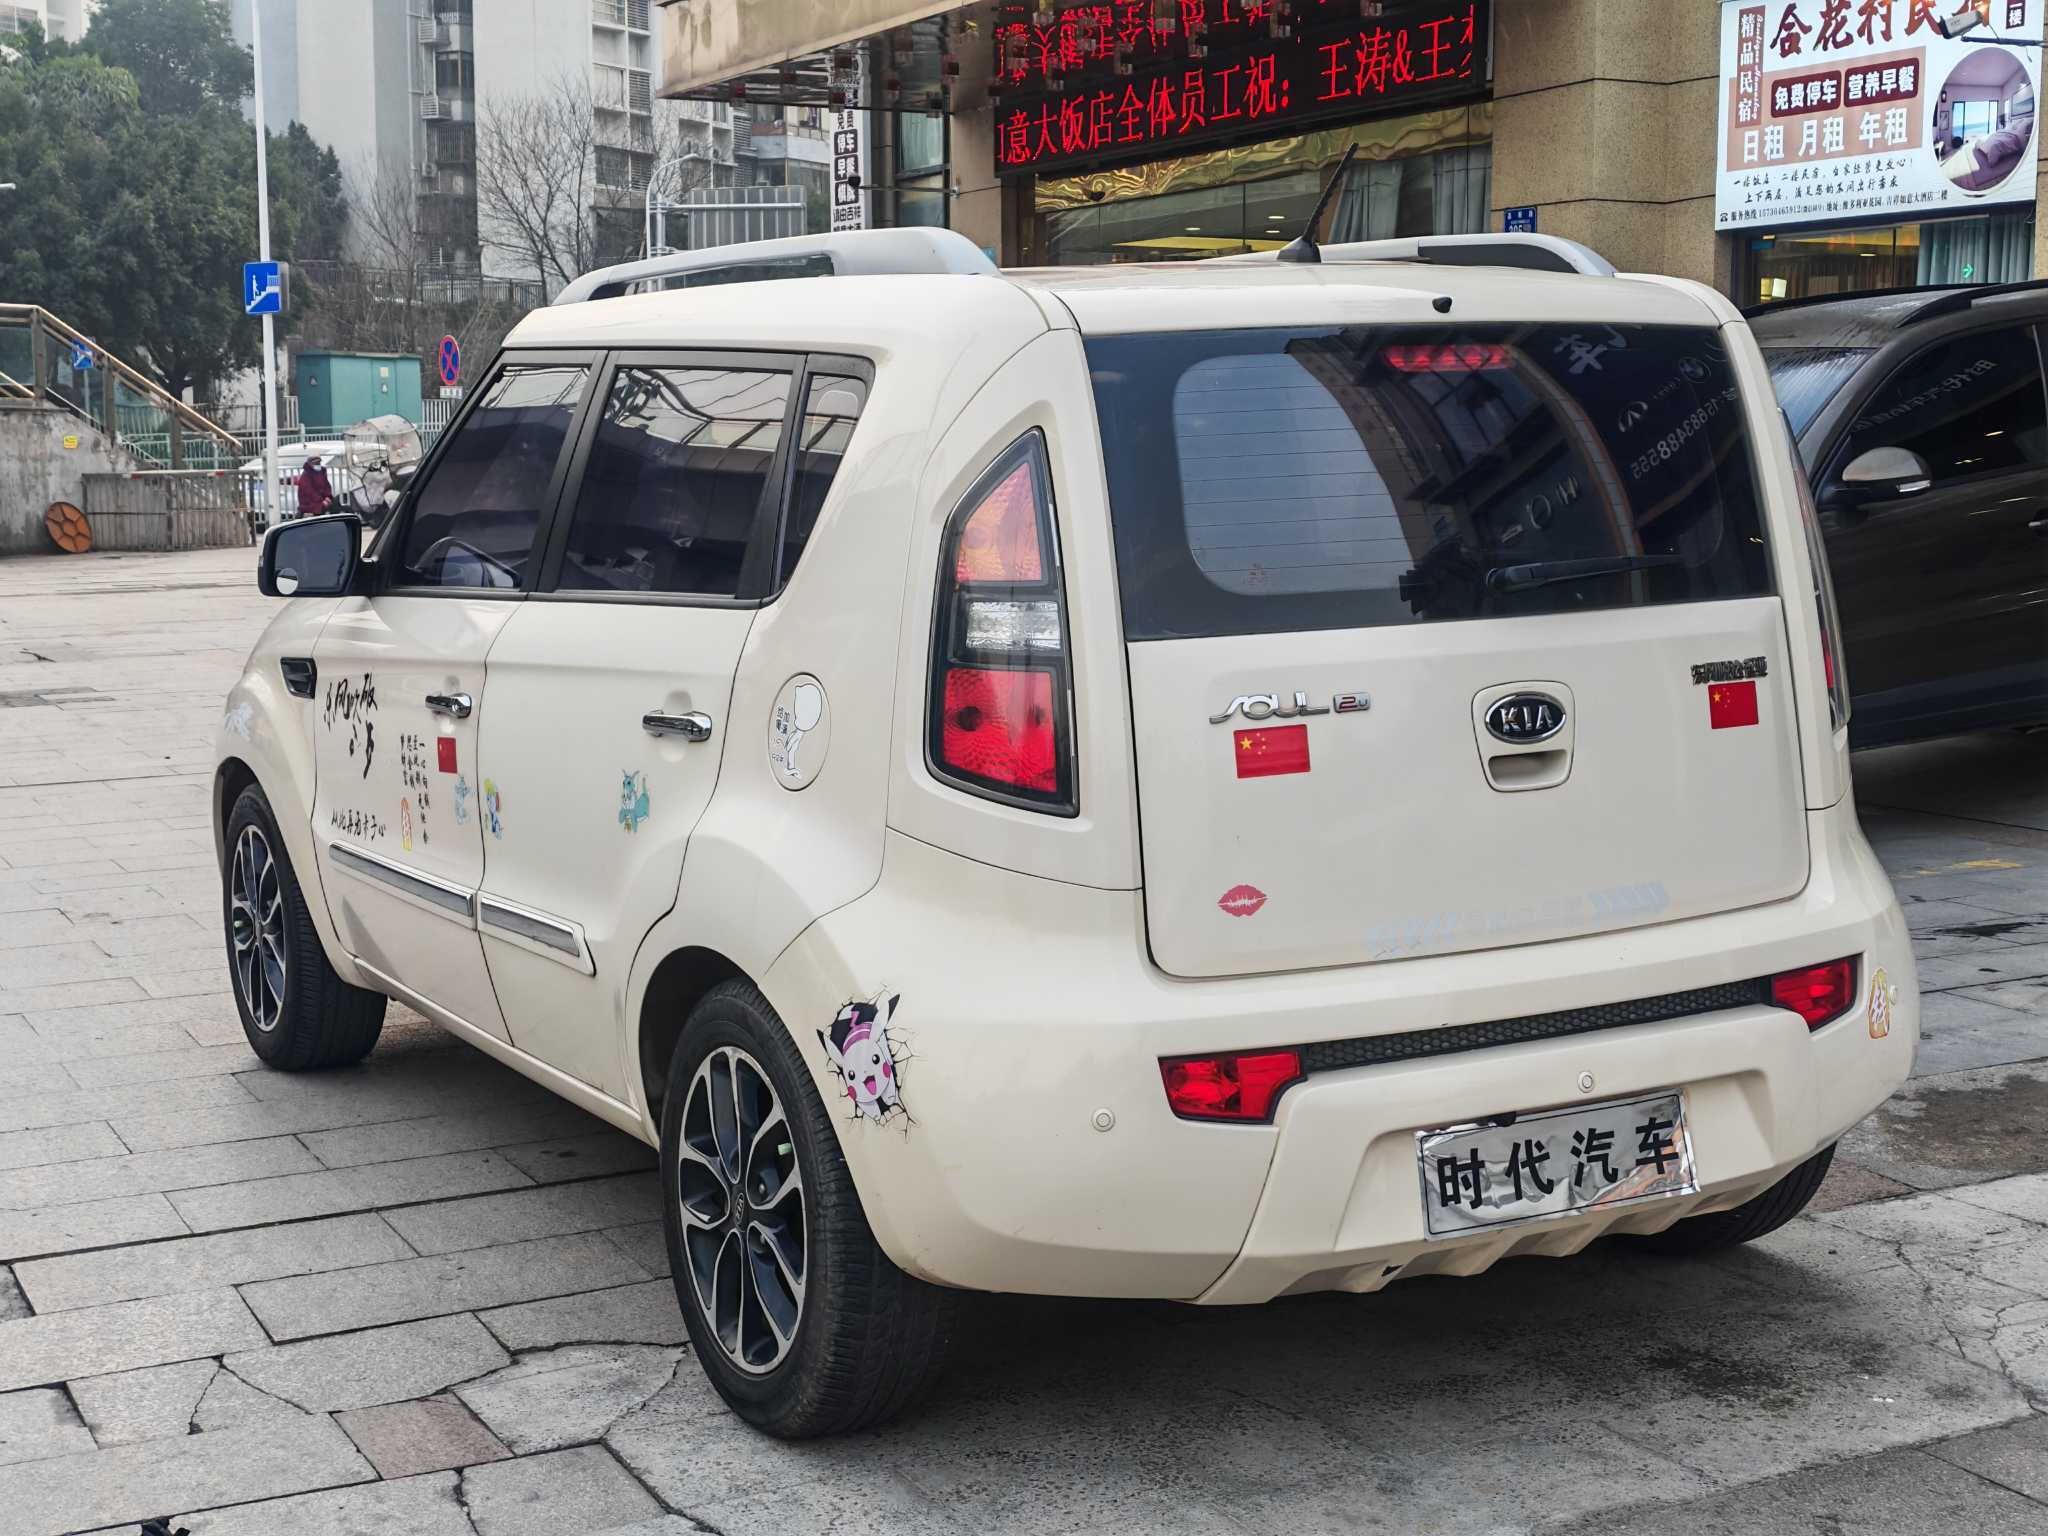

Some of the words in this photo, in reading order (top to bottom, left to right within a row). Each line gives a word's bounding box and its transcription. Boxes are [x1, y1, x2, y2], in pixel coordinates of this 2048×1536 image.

[1738, 12, 1757, 122] 精品民宿
[1774, 78, 1838, 111] 免费停车
[1847, 65, 1915, 100] 营养早餐
[997, 53, 1290, 163] 意大饭店全体员工祝：
[1742, 124, 1785, 164] 日租
[1798, 116, 1845, 157] 月租
[1858, 107, 1908, 149] 年租
[1209, 690, 1331, 725] SOUL
[1499, 704, 1554, 733] KIA
[1436, 1116, 1679, 1210] 时代汽车
